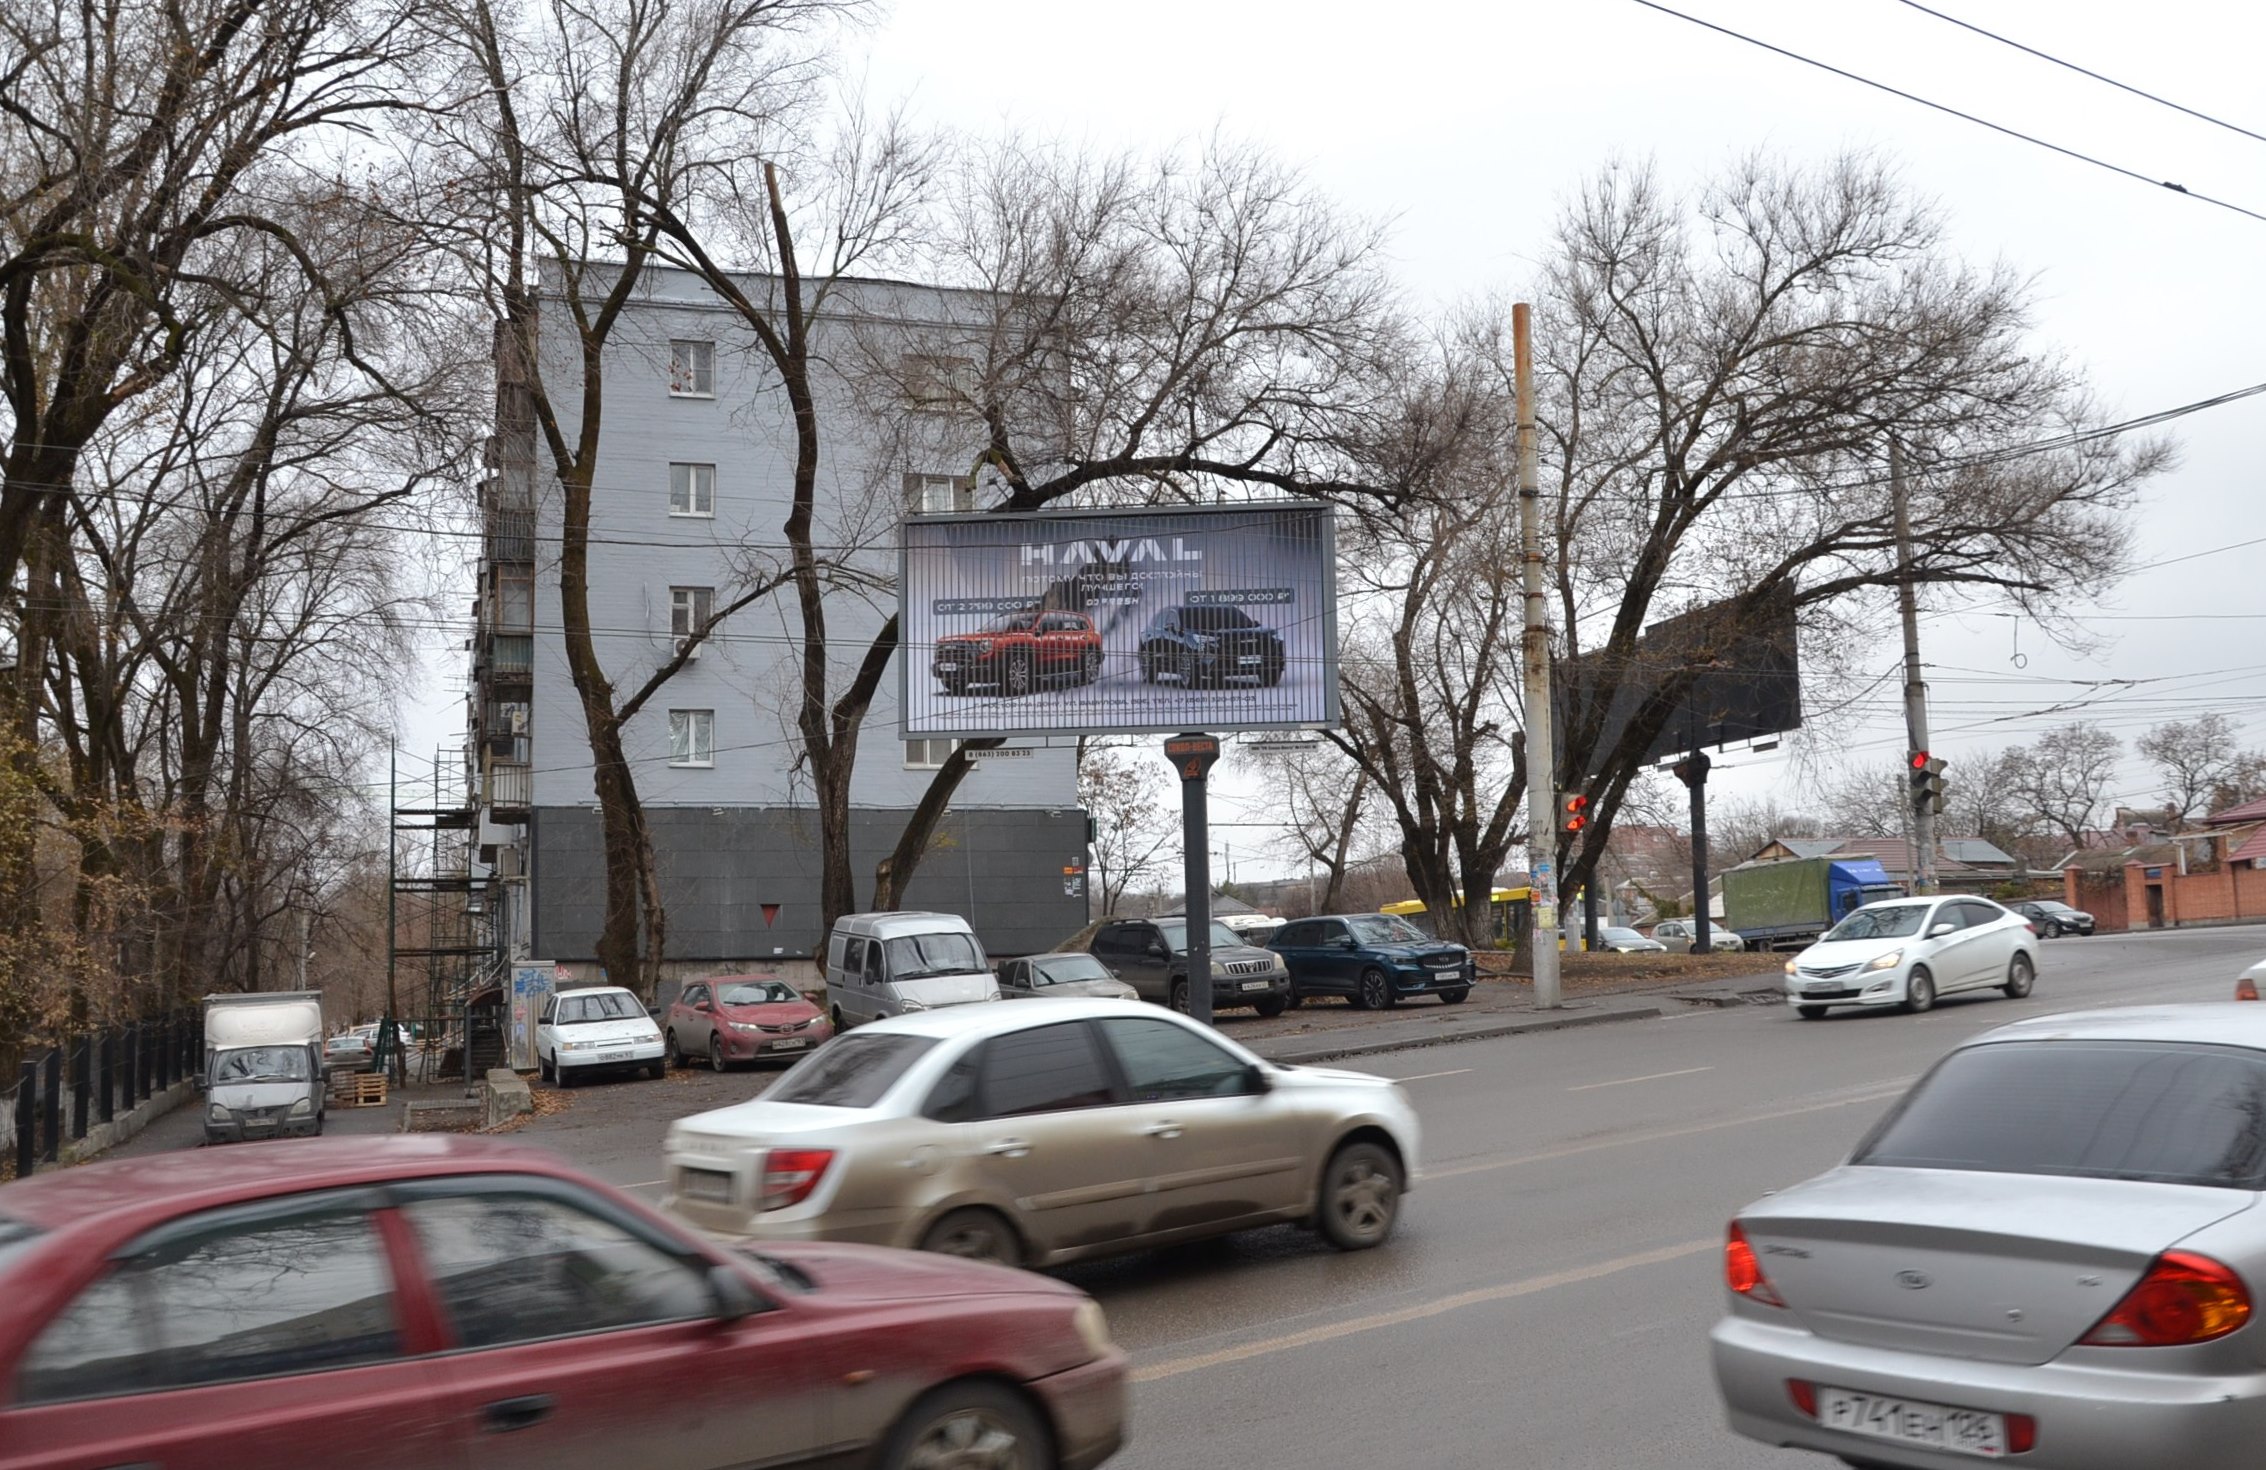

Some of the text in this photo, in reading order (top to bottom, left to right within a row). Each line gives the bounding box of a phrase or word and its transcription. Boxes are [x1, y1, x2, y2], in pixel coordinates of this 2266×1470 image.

[1021, 538, 1203, 566] HAVAL
[1078, 572, 1105, 583] ЧТО
[1108, 572, 1128, 582] ВЫ
[1247, 592, 1274, 602] 000
